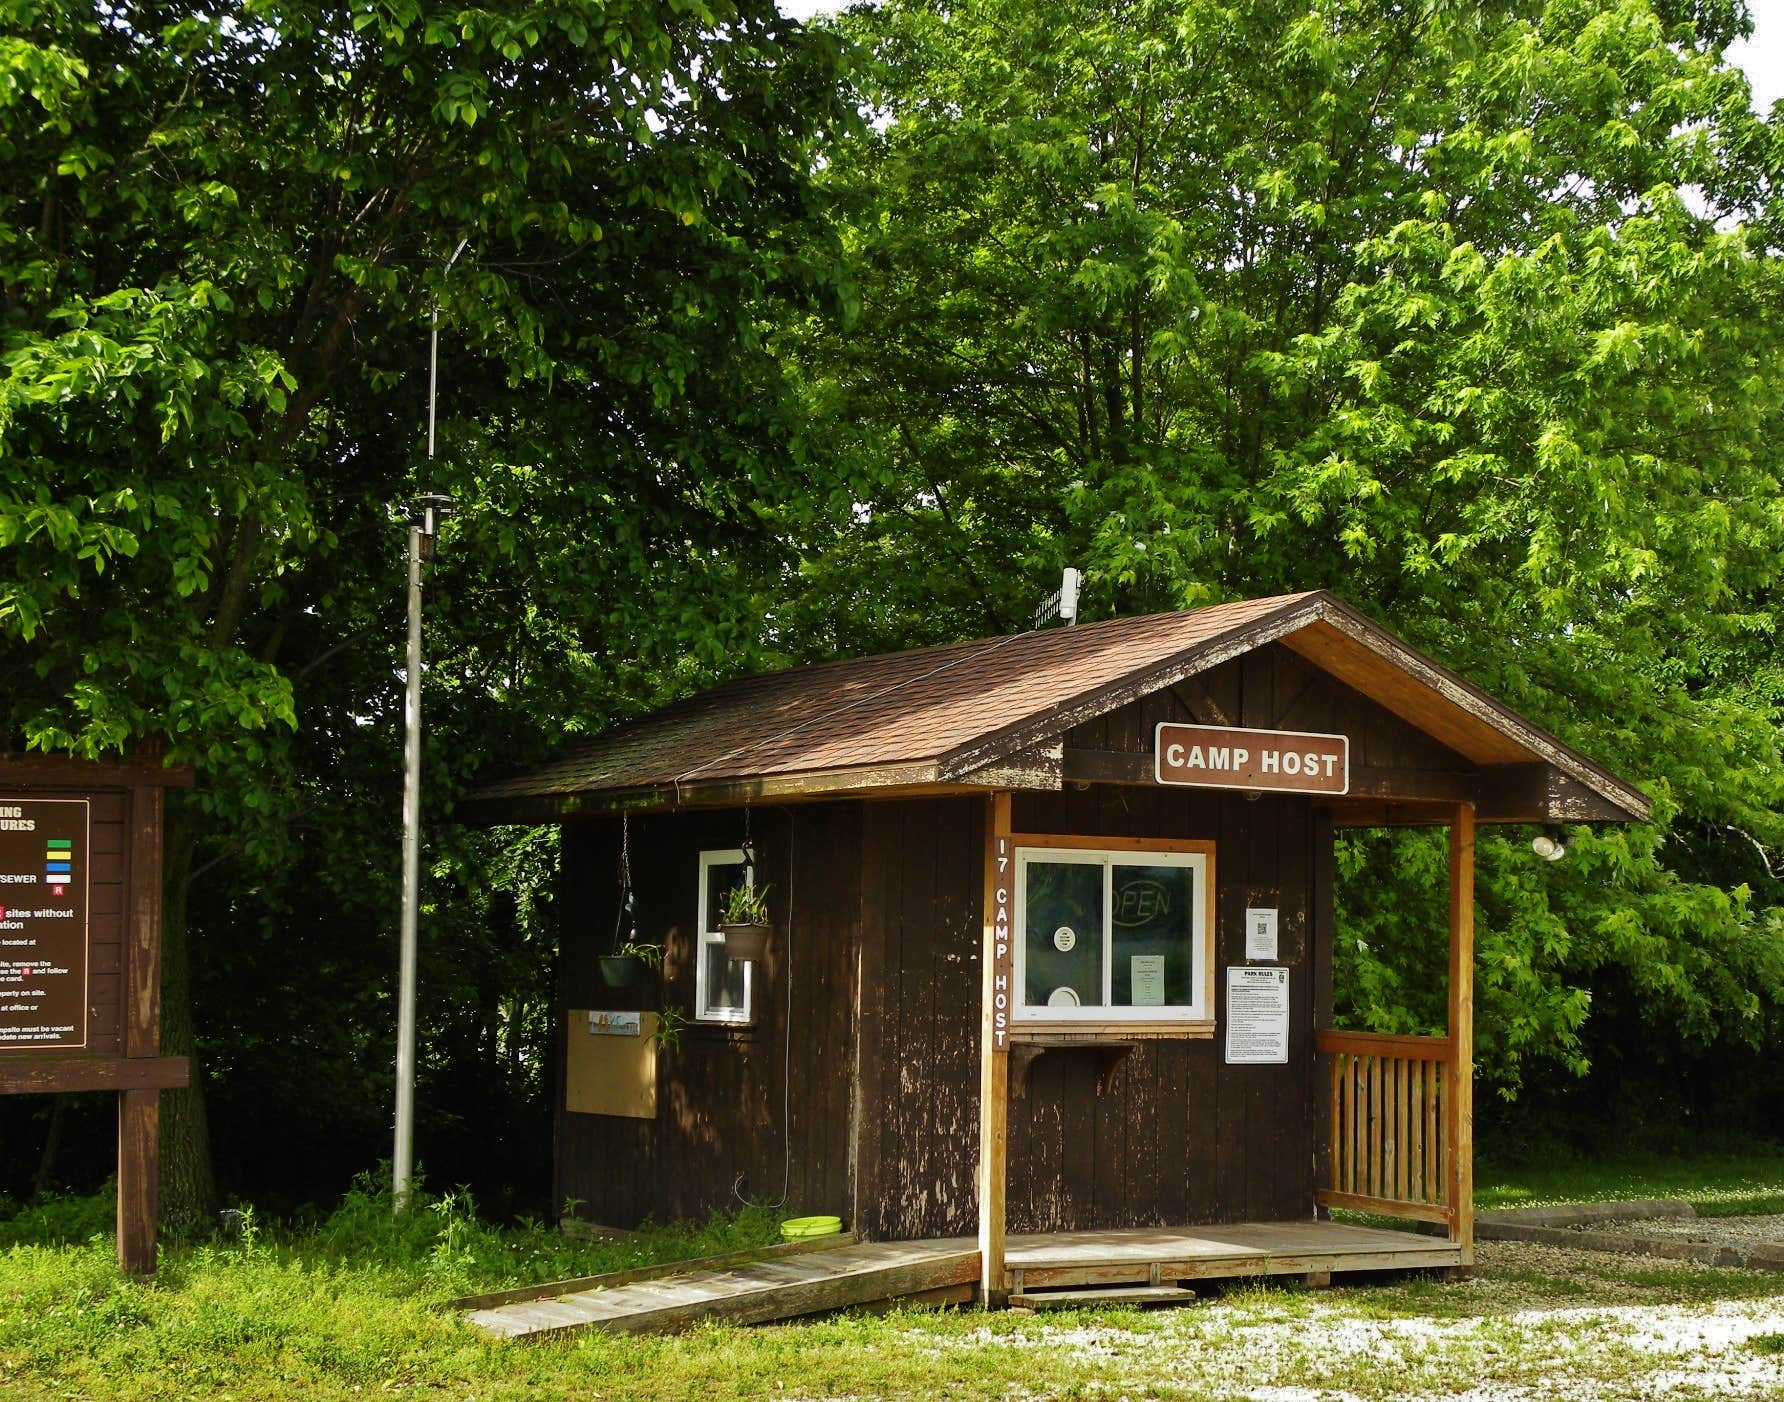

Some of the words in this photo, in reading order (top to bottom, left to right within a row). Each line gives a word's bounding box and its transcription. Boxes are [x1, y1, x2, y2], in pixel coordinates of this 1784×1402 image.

[1166, 743, 1249, 771] CAMP
[1261, 750, 1338, 777] HOST
[997, 839, 1008, 873] 17
[55, 886, 63, 894] R
[5, 909, 31, 918] sites
[34, 908, 74, 918] without
[995, 887, 1008, 960] CAMP
[994, 975, 1007, 1046] HOST
